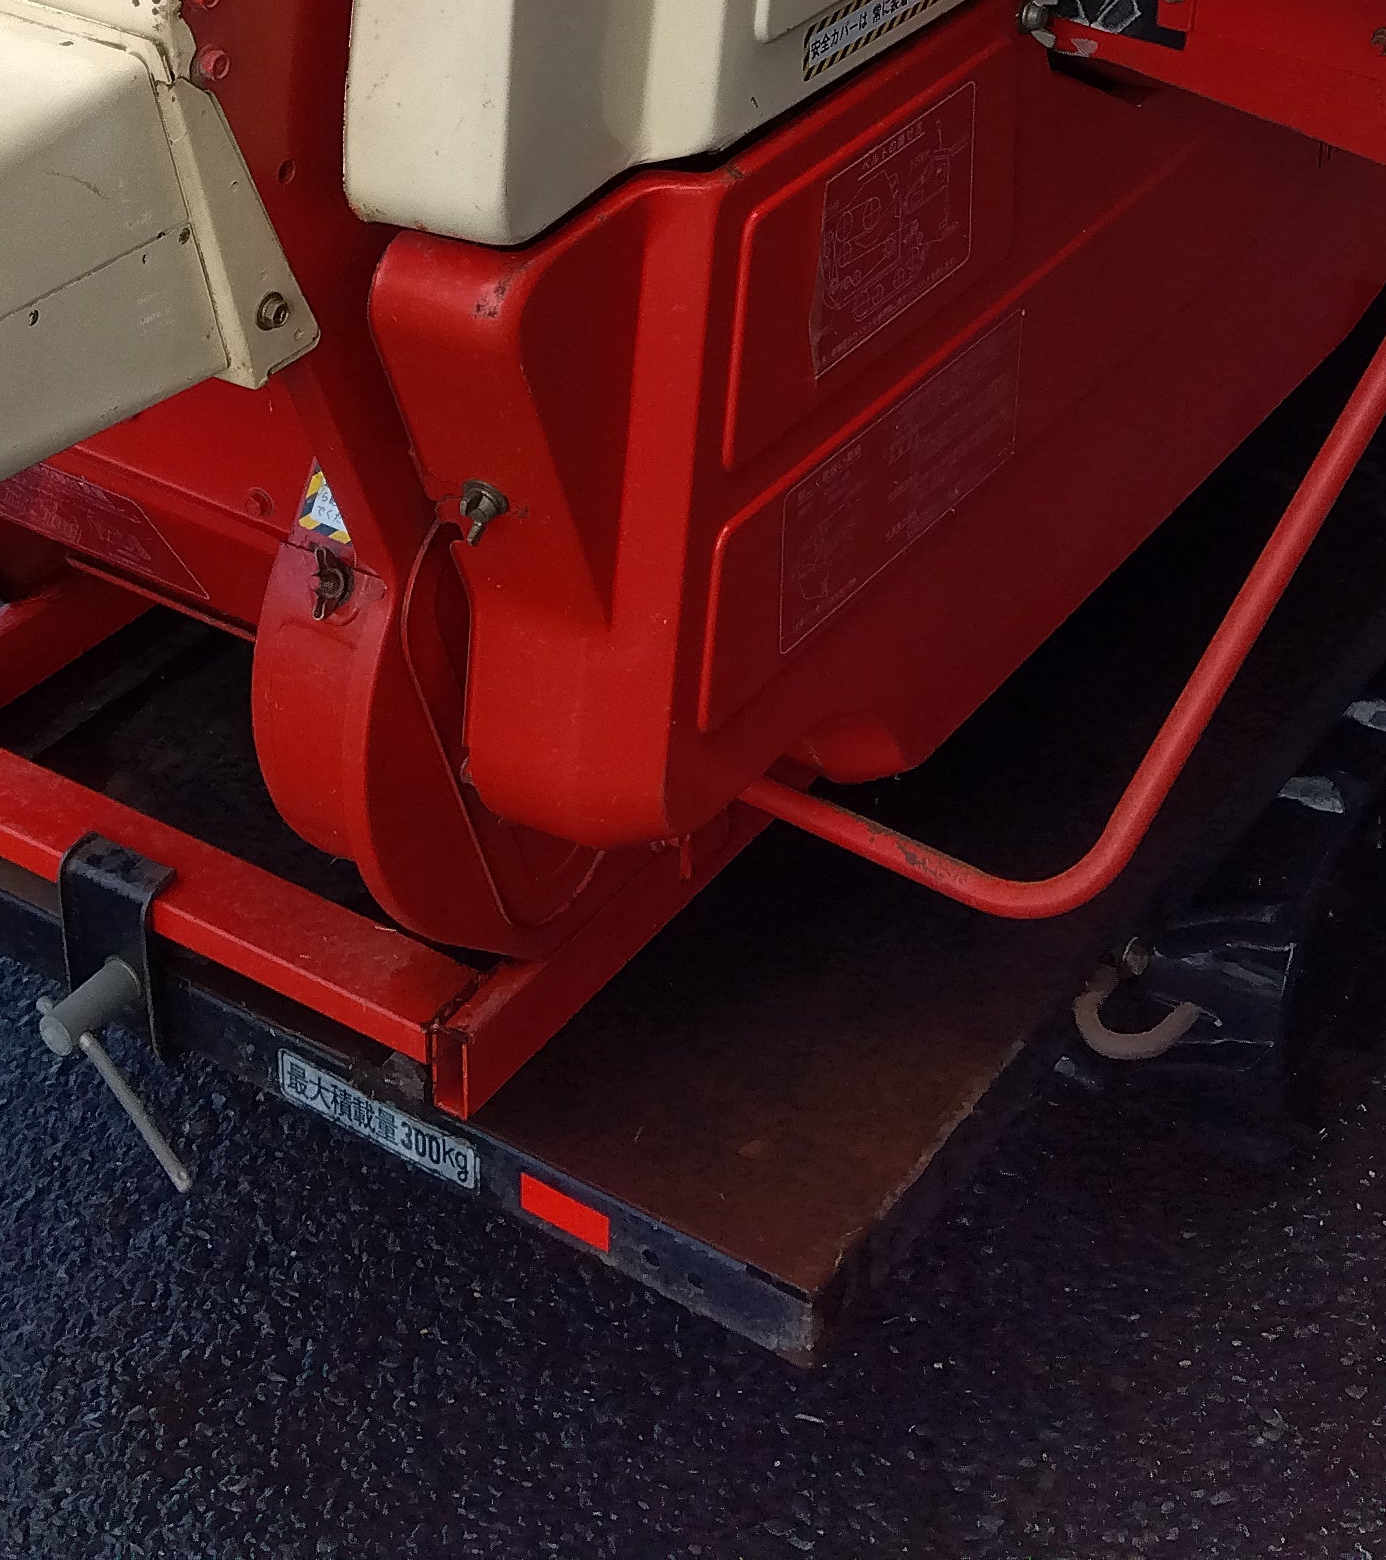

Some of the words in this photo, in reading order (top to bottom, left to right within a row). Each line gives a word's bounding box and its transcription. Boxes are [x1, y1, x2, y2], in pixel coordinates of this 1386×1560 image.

[810, 11, 868, 60] 安全カバーは
[286, 1060, 470, 1185] 最大積載量300kg
